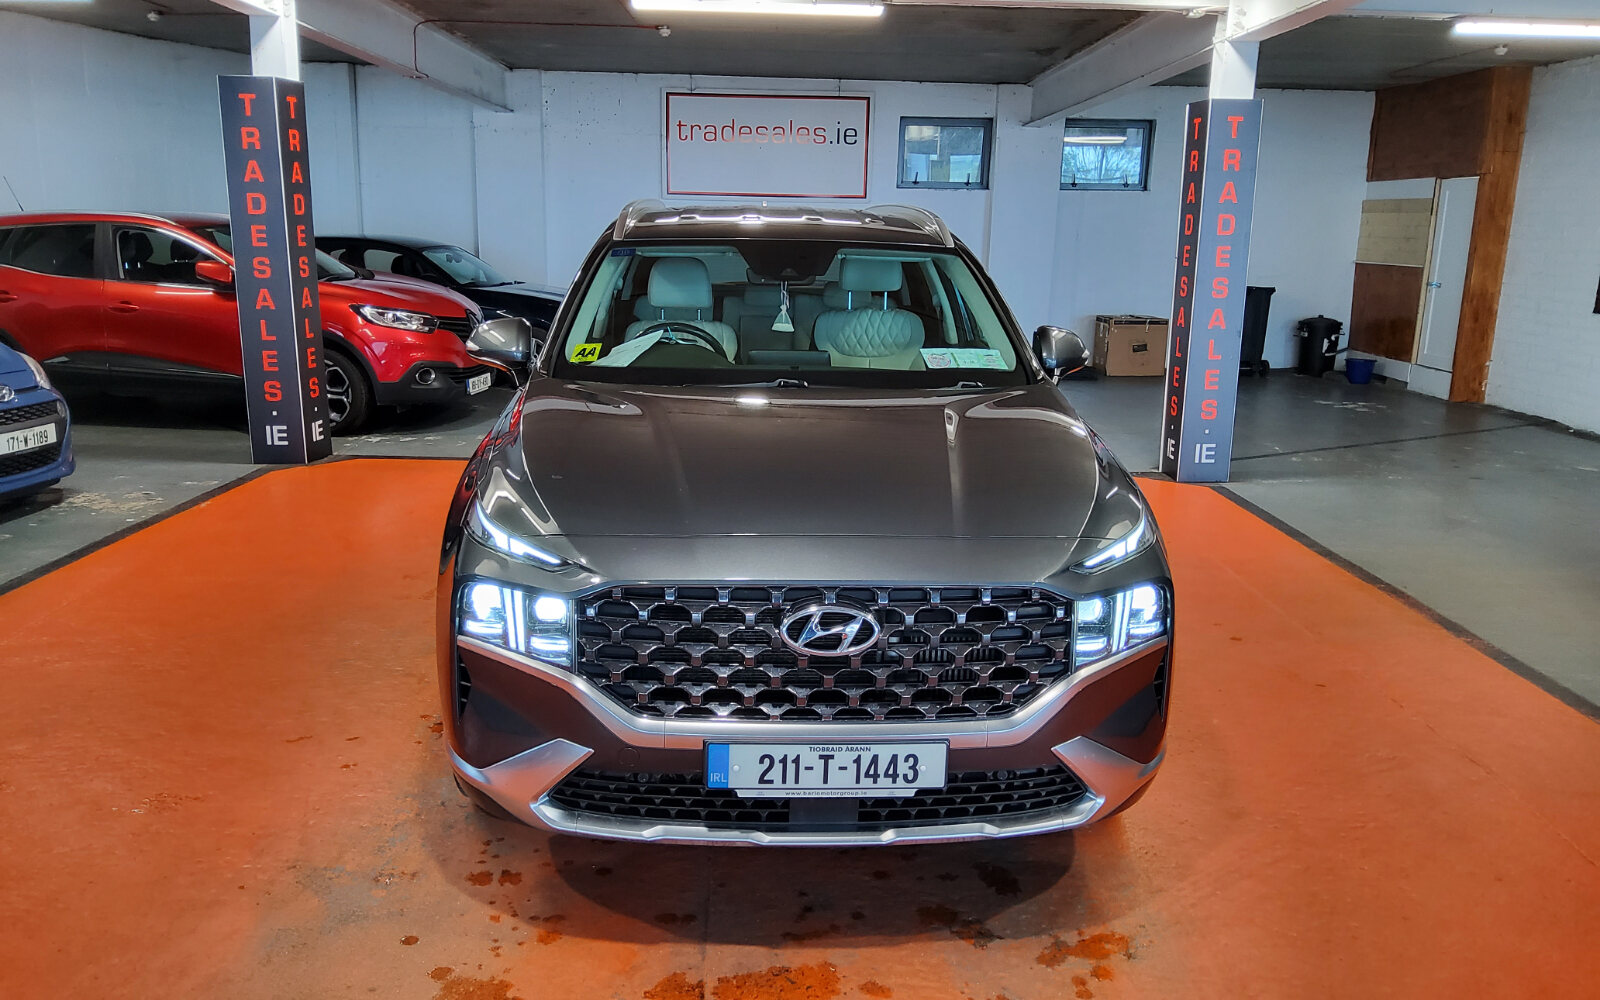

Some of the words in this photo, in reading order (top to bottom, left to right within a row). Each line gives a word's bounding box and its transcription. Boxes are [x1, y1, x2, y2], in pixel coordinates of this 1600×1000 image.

[676, 118, 858, 145] tradesales.ie
[238, 93, 289, 446] TRADESALES.IE
[286, 96, 325, 442] TRADESALES.IE
[1166, 117, 1201, 460] TRADESALES.IE
[1194, 116, 1244, 464] TRADESALES.IE
[575, 347, 597, 358] AA
[7, 429, 49, 452] 171-W-1189
[710, 772, 728, 783] IRL
[758, 753, 920, 785] 211-T-1443
